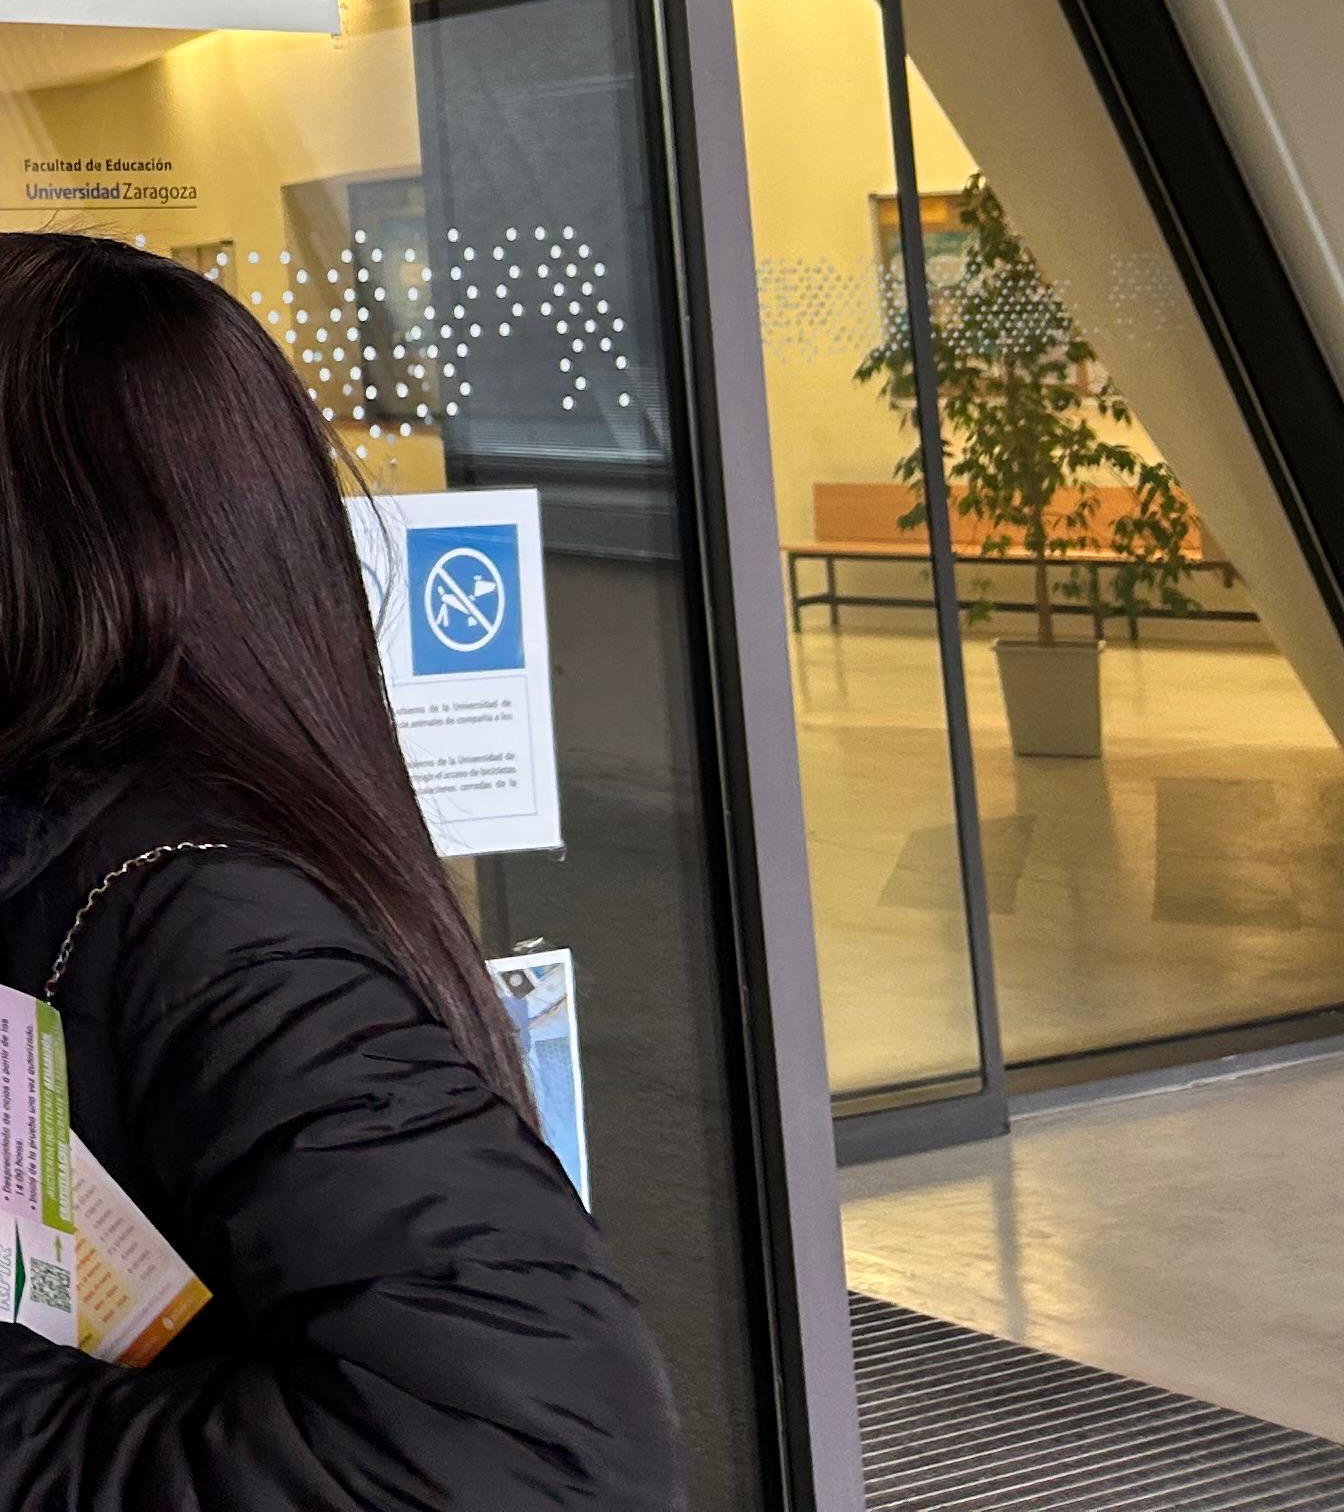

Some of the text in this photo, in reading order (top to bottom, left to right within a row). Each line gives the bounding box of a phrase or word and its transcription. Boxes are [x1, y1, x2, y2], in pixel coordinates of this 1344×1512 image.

[24, 158, 172, 172] Facultad de Educación
